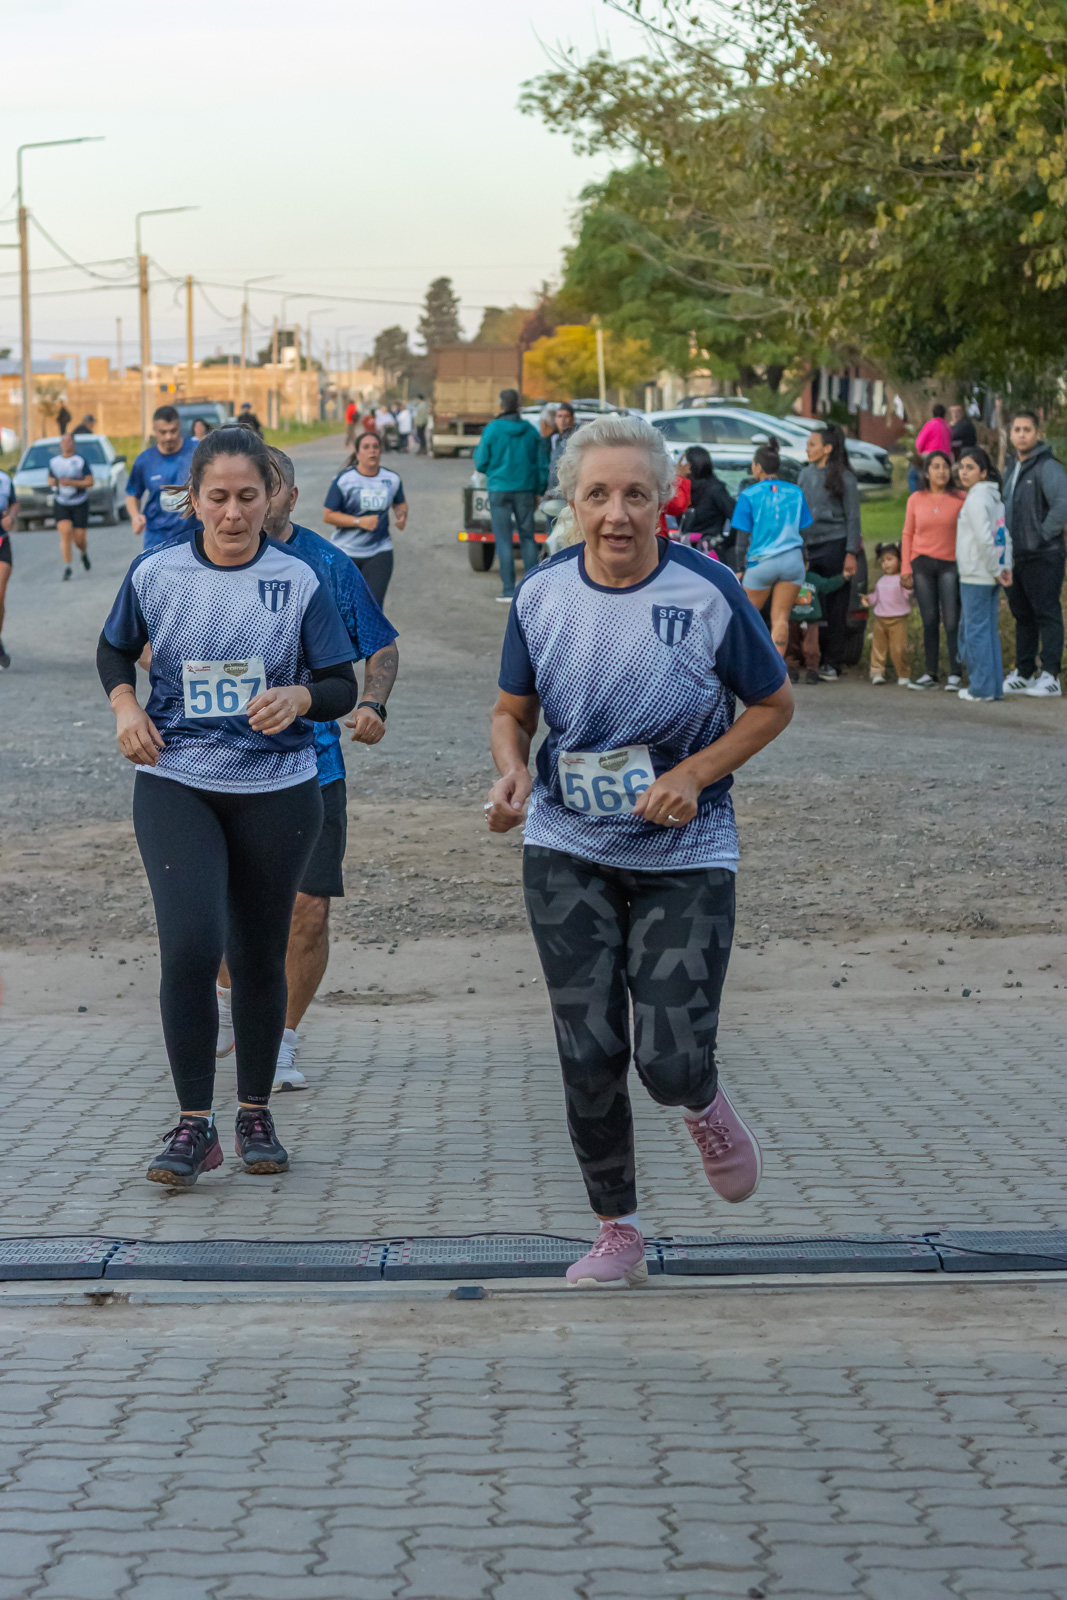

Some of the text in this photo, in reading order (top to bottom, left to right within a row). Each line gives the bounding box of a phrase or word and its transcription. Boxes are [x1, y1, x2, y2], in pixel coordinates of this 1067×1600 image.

[363, 496, 385, 508] 507
[264, 582, 286, 591] SFC
[659, 608, 686, 621] SFC
[189, 677, 262, 714] 567
[565, 769, 650, 813] 566
